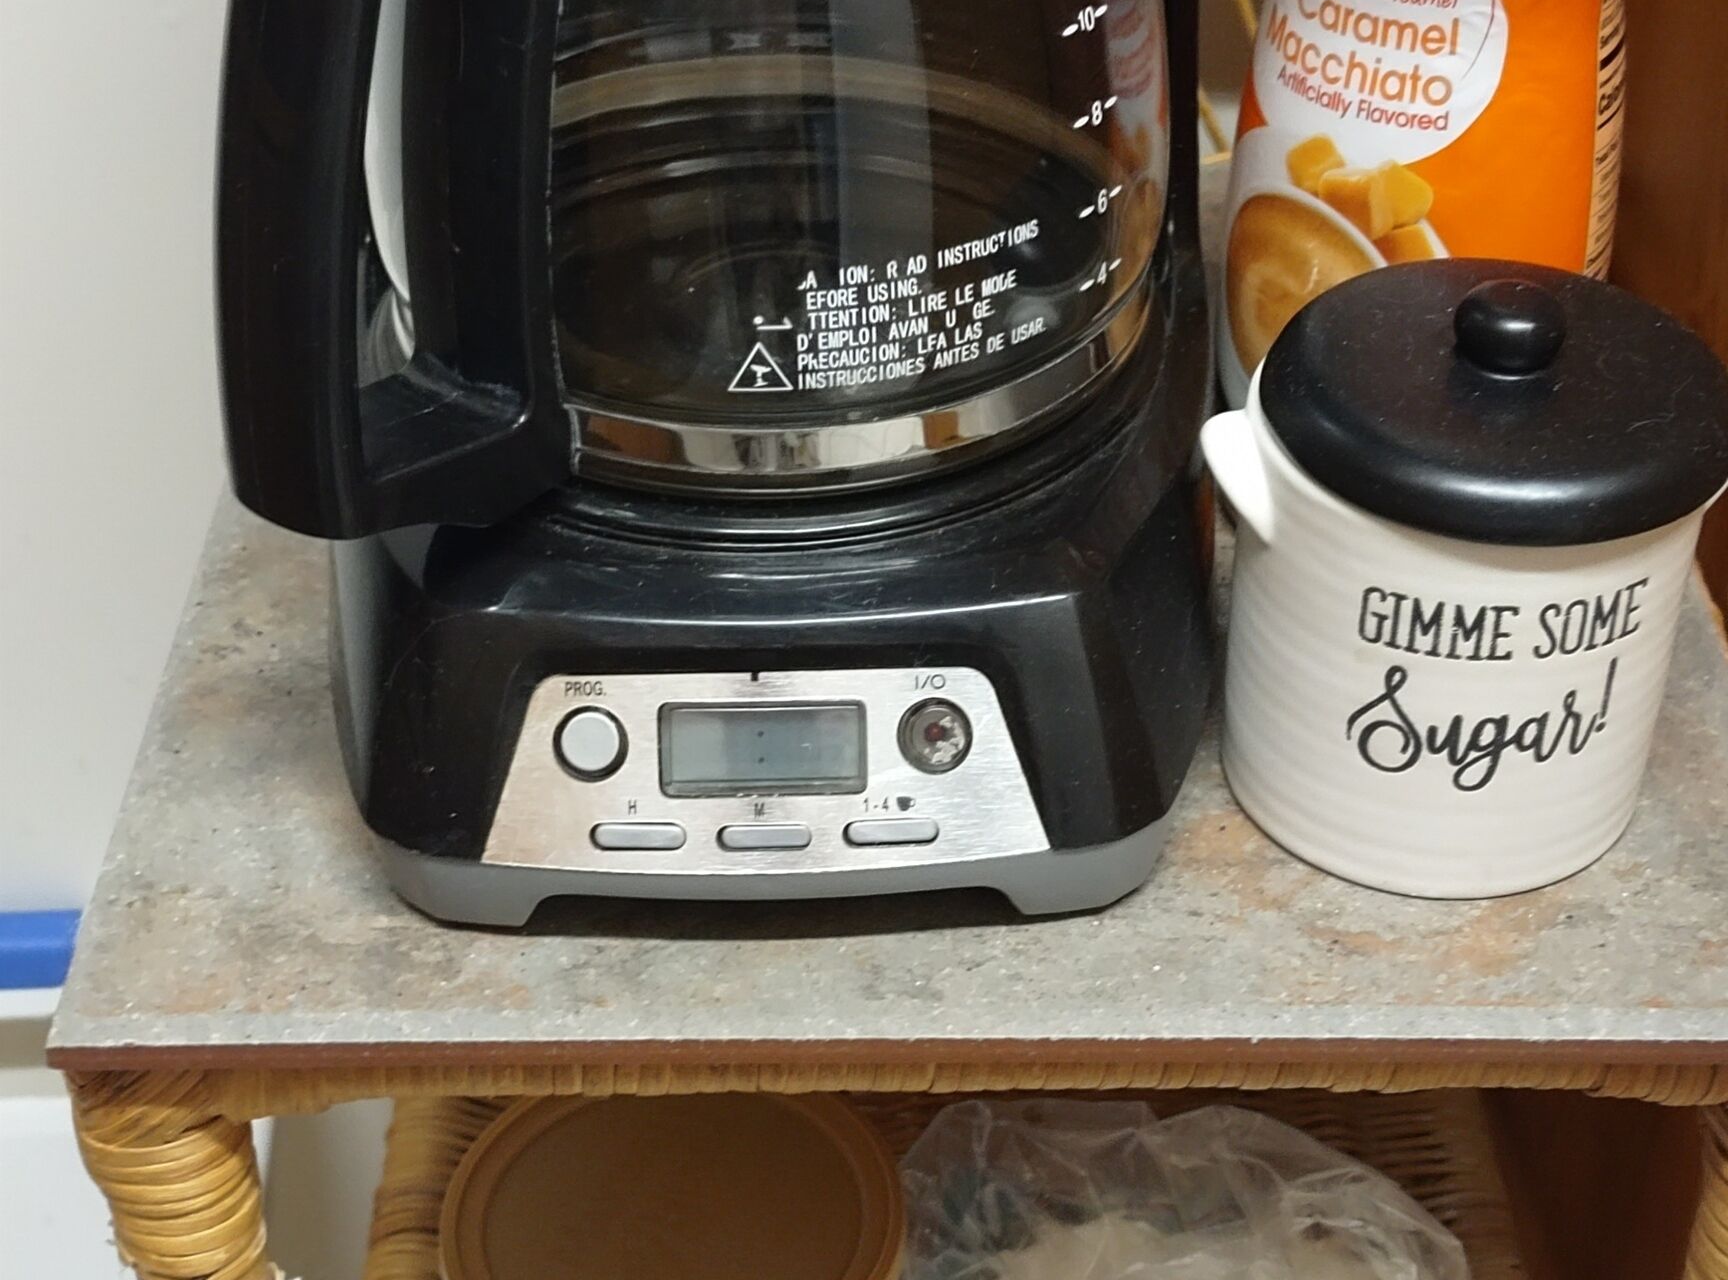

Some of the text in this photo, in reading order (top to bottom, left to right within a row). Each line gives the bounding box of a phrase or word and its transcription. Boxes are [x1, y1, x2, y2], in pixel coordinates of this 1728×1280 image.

[1077, 5, 1096, 32] 10
[1266, 3, 1454, 108] Macchiato
[1090, 98, 1103, 127] 8
[1276, 64, 1450, 131] Artificially Flavored
[1097, 188, 1108, 215] 6
[886, 254, 928, 279] RAD
[937, 218, 1040, 269] INSTRUCTIONS
[1096, 261, 1108, 286] 4
[805, 277, 923, 311] EFORE USING.
[908, 290, 948, 318] LIRE
[954, 283, 975, 307] LE
[888, 316, 930, 342] AVAN
[954, 322, 984, 346] LAS
[797, 316, 1048, 391] INSTRUCCIONES ANTES DE USAR.
[1358, 576, 1650, 662] GIMME SOME
[563, 680, 608, 698] PROG.
[1346, 656, 1618, 792] Sugar!
[627, 799, 638, 816] H
[753, 802, 766, 818] M
